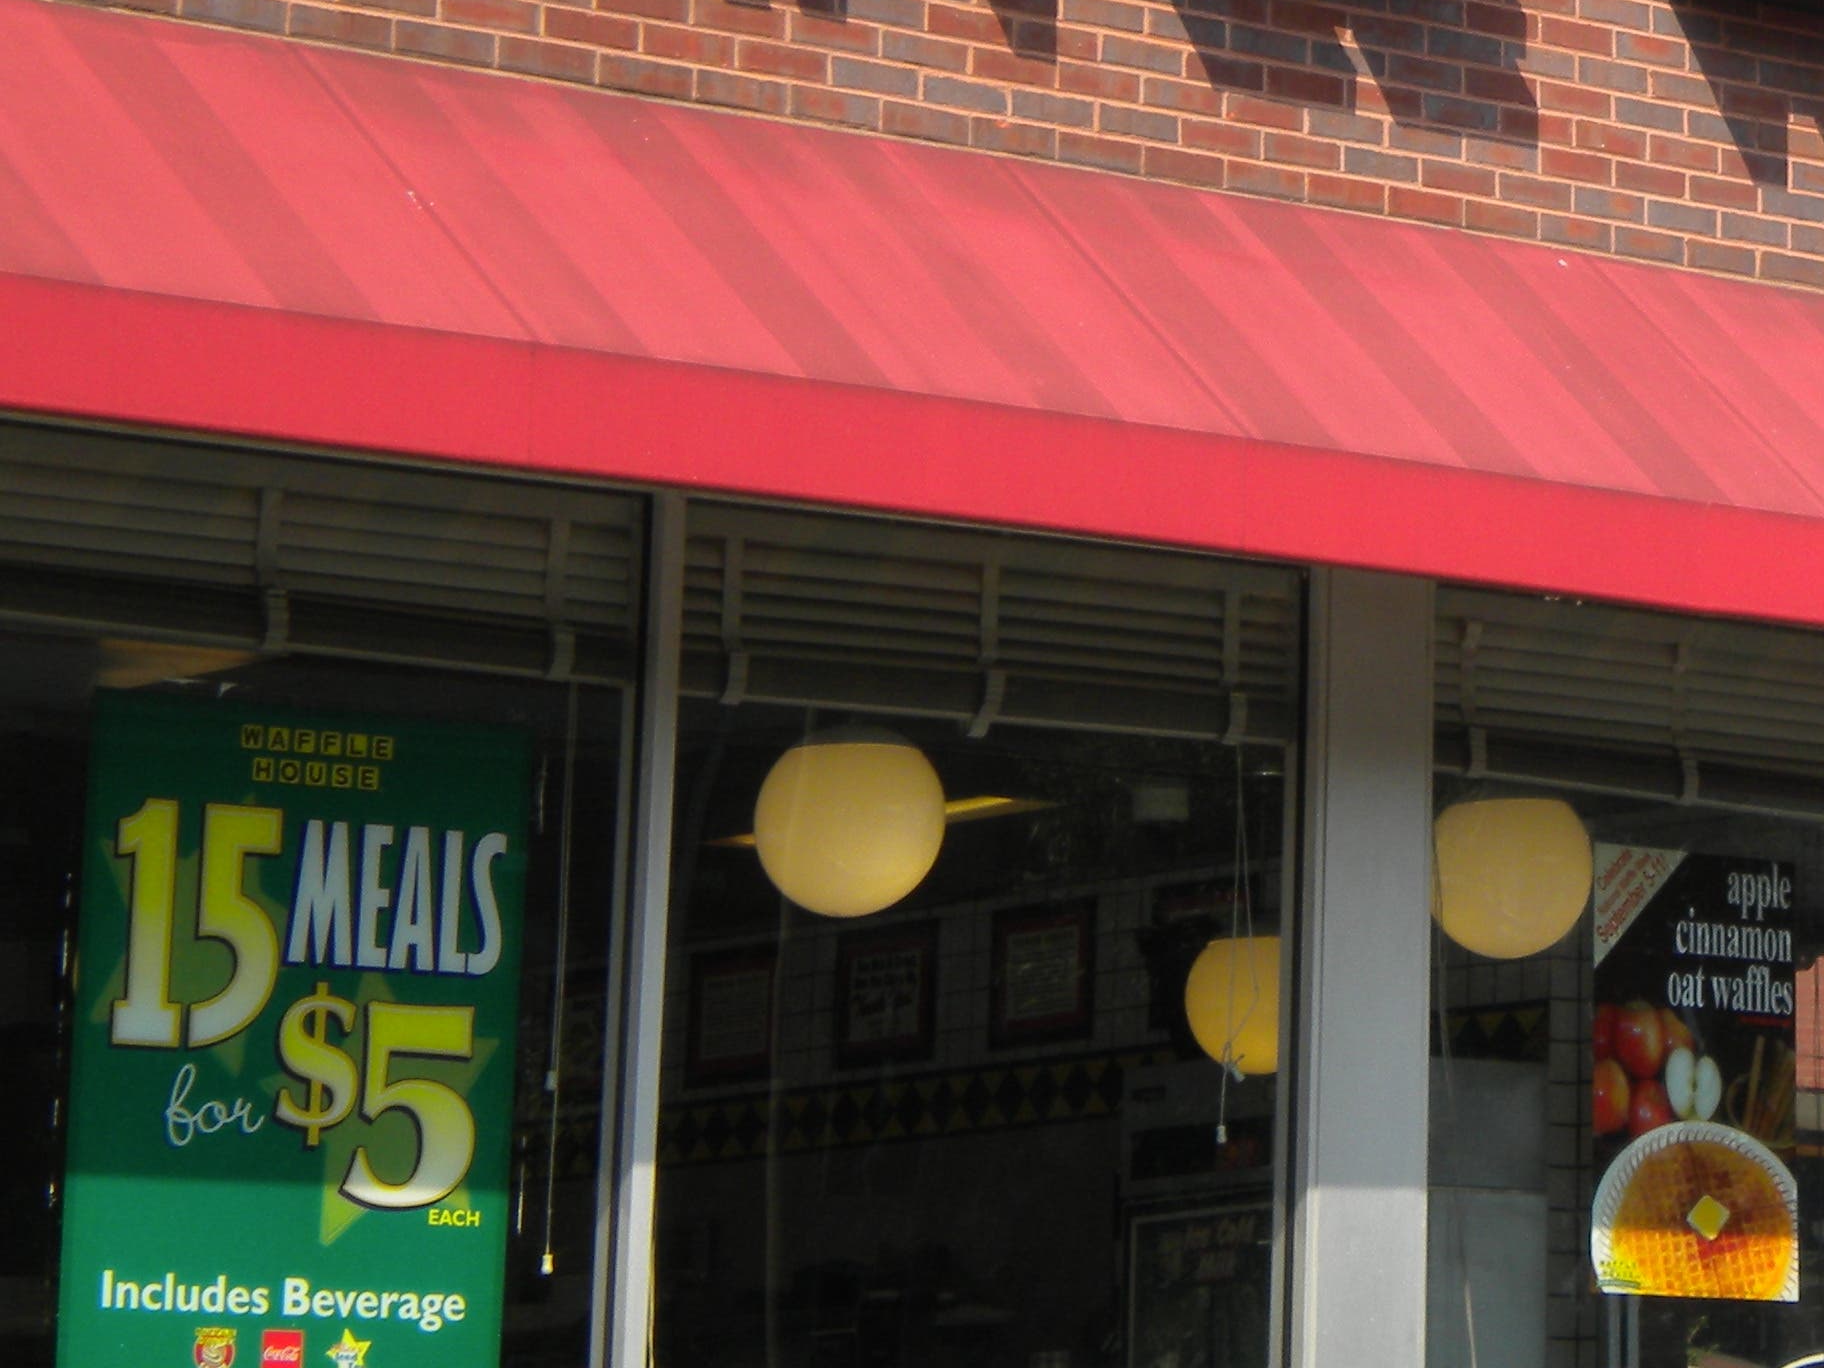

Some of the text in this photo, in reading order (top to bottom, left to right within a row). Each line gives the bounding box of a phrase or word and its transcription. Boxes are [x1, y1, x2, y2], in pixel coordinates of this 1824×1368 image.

[243, 725, 392, 759] WAFFLE
[254, 758, 381, 790] HOUSE
[1728, 863, 1792, 921] apple
[110, 798, 507, 1048] 15 MEALS
[1675, 907, 1793, 962] cinnamon
[1667, 964, 1794, 1015] oat waffles
[164, 982, 476, 1207] for $5
[428, 1209, 480, 1228] EACH
[101, 1269, 466, 1332] Includes Beverage
